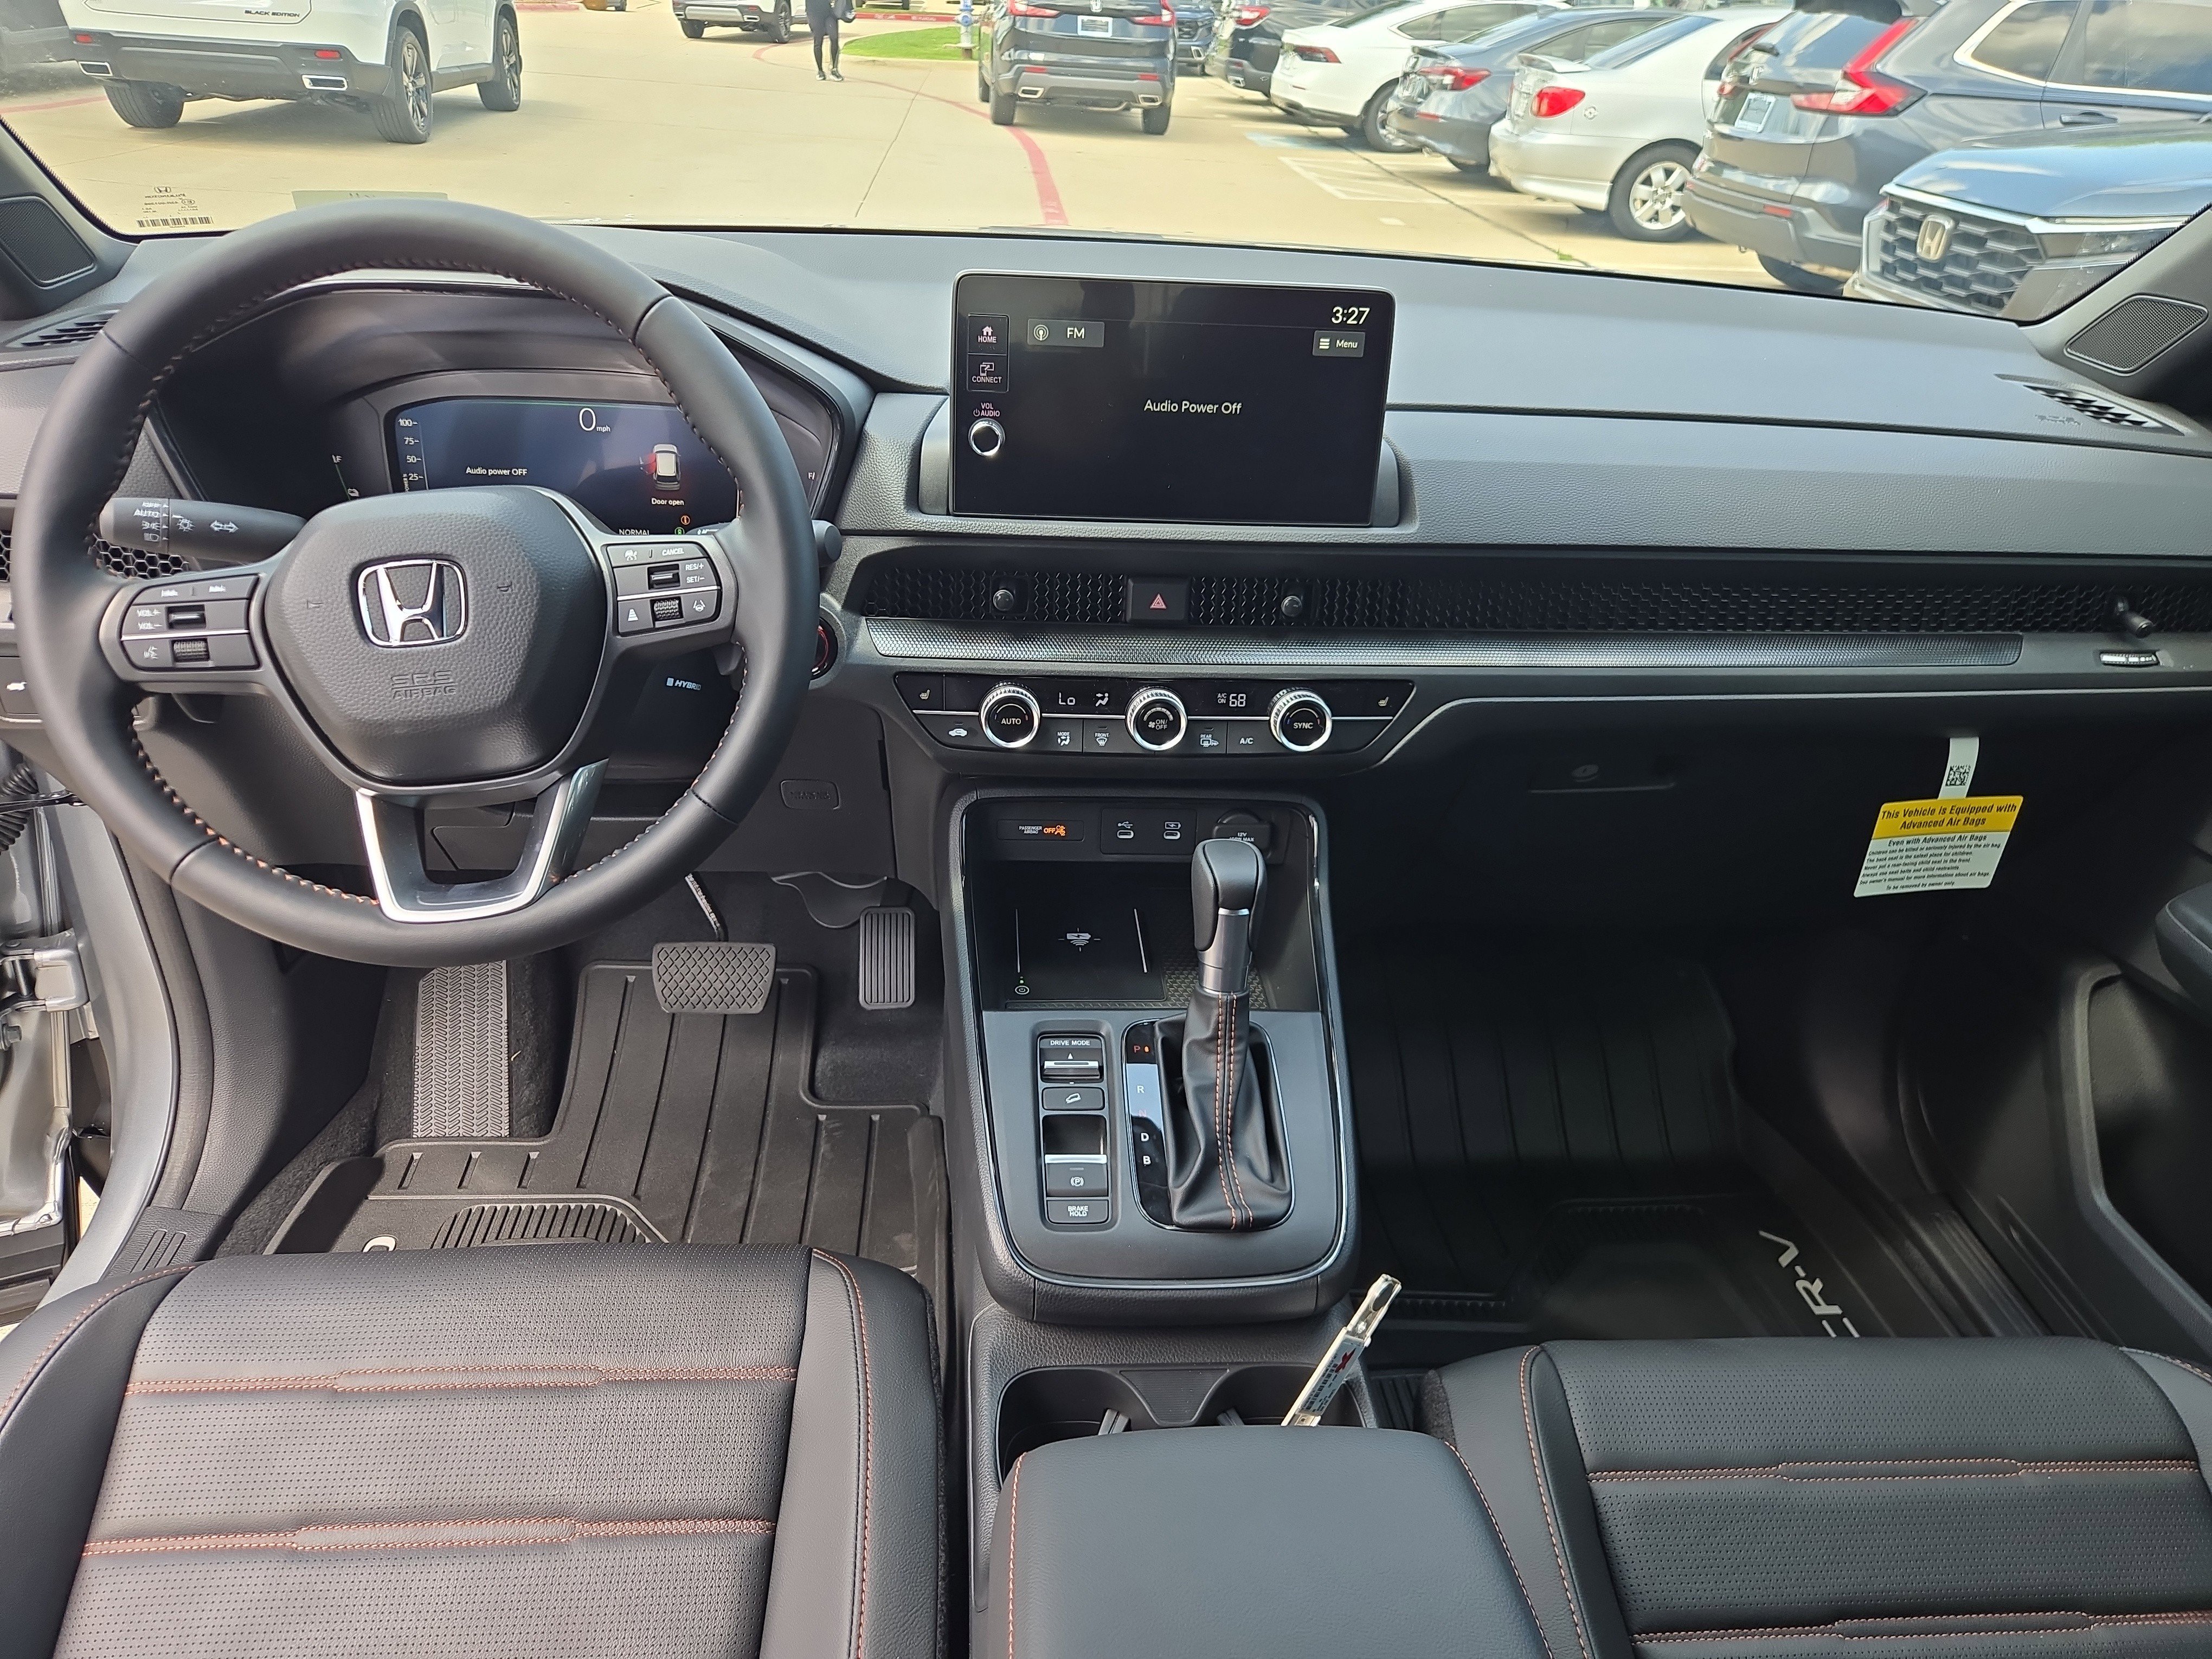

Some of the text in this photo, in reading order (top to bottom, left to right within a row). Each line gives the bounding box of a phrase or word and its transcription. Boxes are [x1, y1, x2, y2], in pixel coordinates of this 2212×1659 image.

[1332, 306, 1370, 324] 3:27
[1067, 327, 1085, 339] FM
[1336, 339, 1358, 348] Menu
[1144, 399, 1242, 415] Audio Power Off
[398, 418, 414, 427] 100
[579, 408, 596, 430] 0
[403, 436, 414, 445] 75
[466, 466, 487, 474] Audio
[133, 509, 160, 518] AUTO
[662, 548, 684, 556] CANCEL
[390, 670, 451, 686] SRS
[674, 680, 702, 691] HYBRID
[393, 685, 456, 699] AIRBAG
[1059, 692, 1076, 705] Lo
[1229, 693, 1246, 707] 68
[1881, 803, 2017, 820] This Vehicle is Equipped with
[1899, 816, 1986, 829] Advanced Air Bags
[1921, 835, 1956, 844] Advanced
[1969, 834, 1988, 842] Bags
[1134, 1045, 1141, 1053] P
[1137, 1085, 1144, 1094] R
[1141, 1133, 1149, 1142] D
[1143, 1155, 1152, 1165] B
